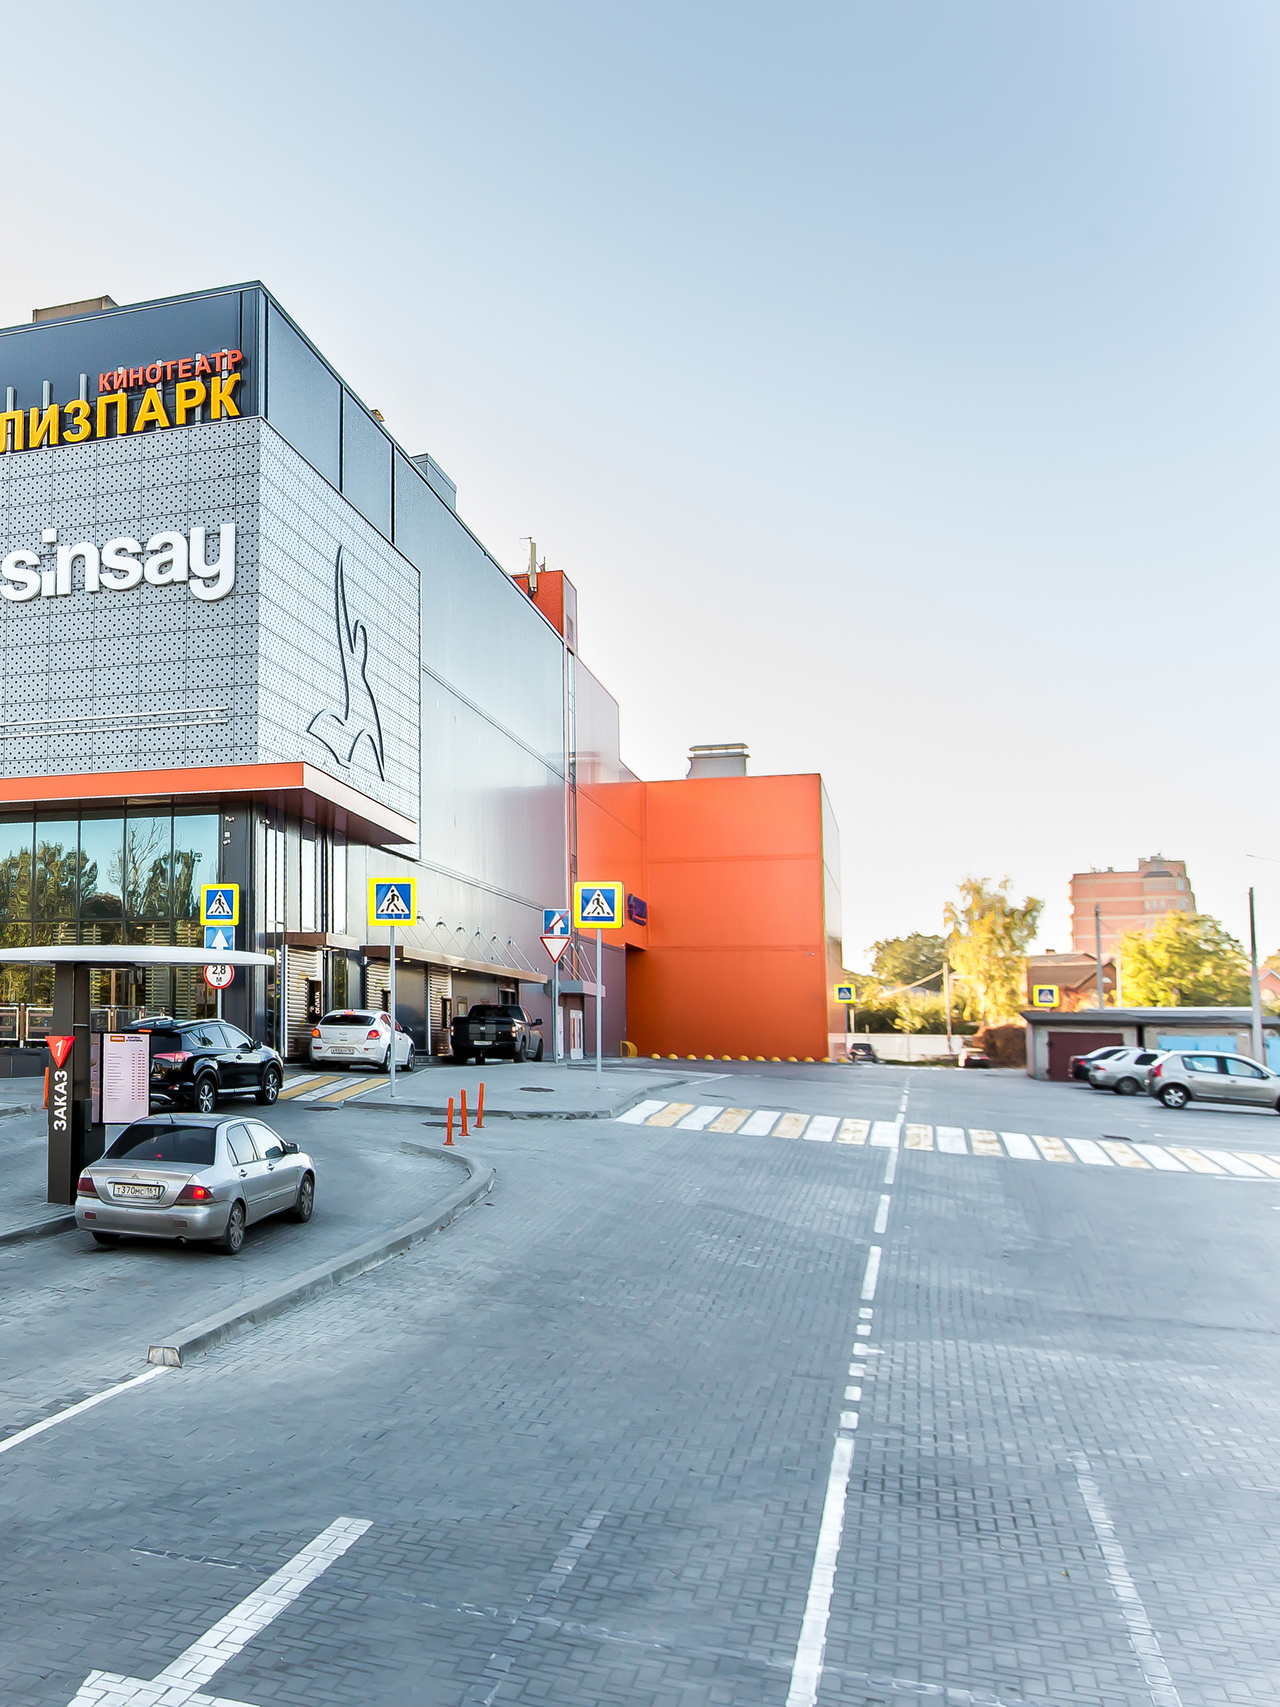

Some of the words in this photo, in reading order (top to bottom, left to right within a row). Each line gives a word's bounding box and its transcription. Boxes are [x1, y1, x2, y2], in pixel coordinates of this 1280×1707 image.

[98, 349, 242, 392] КИНОТЕАТР
[0, 522, 236, 602] sinsay
[55, 1039, 63, 1057] 1
[53, 1070, 68, 1132] ЗАКАЗ
